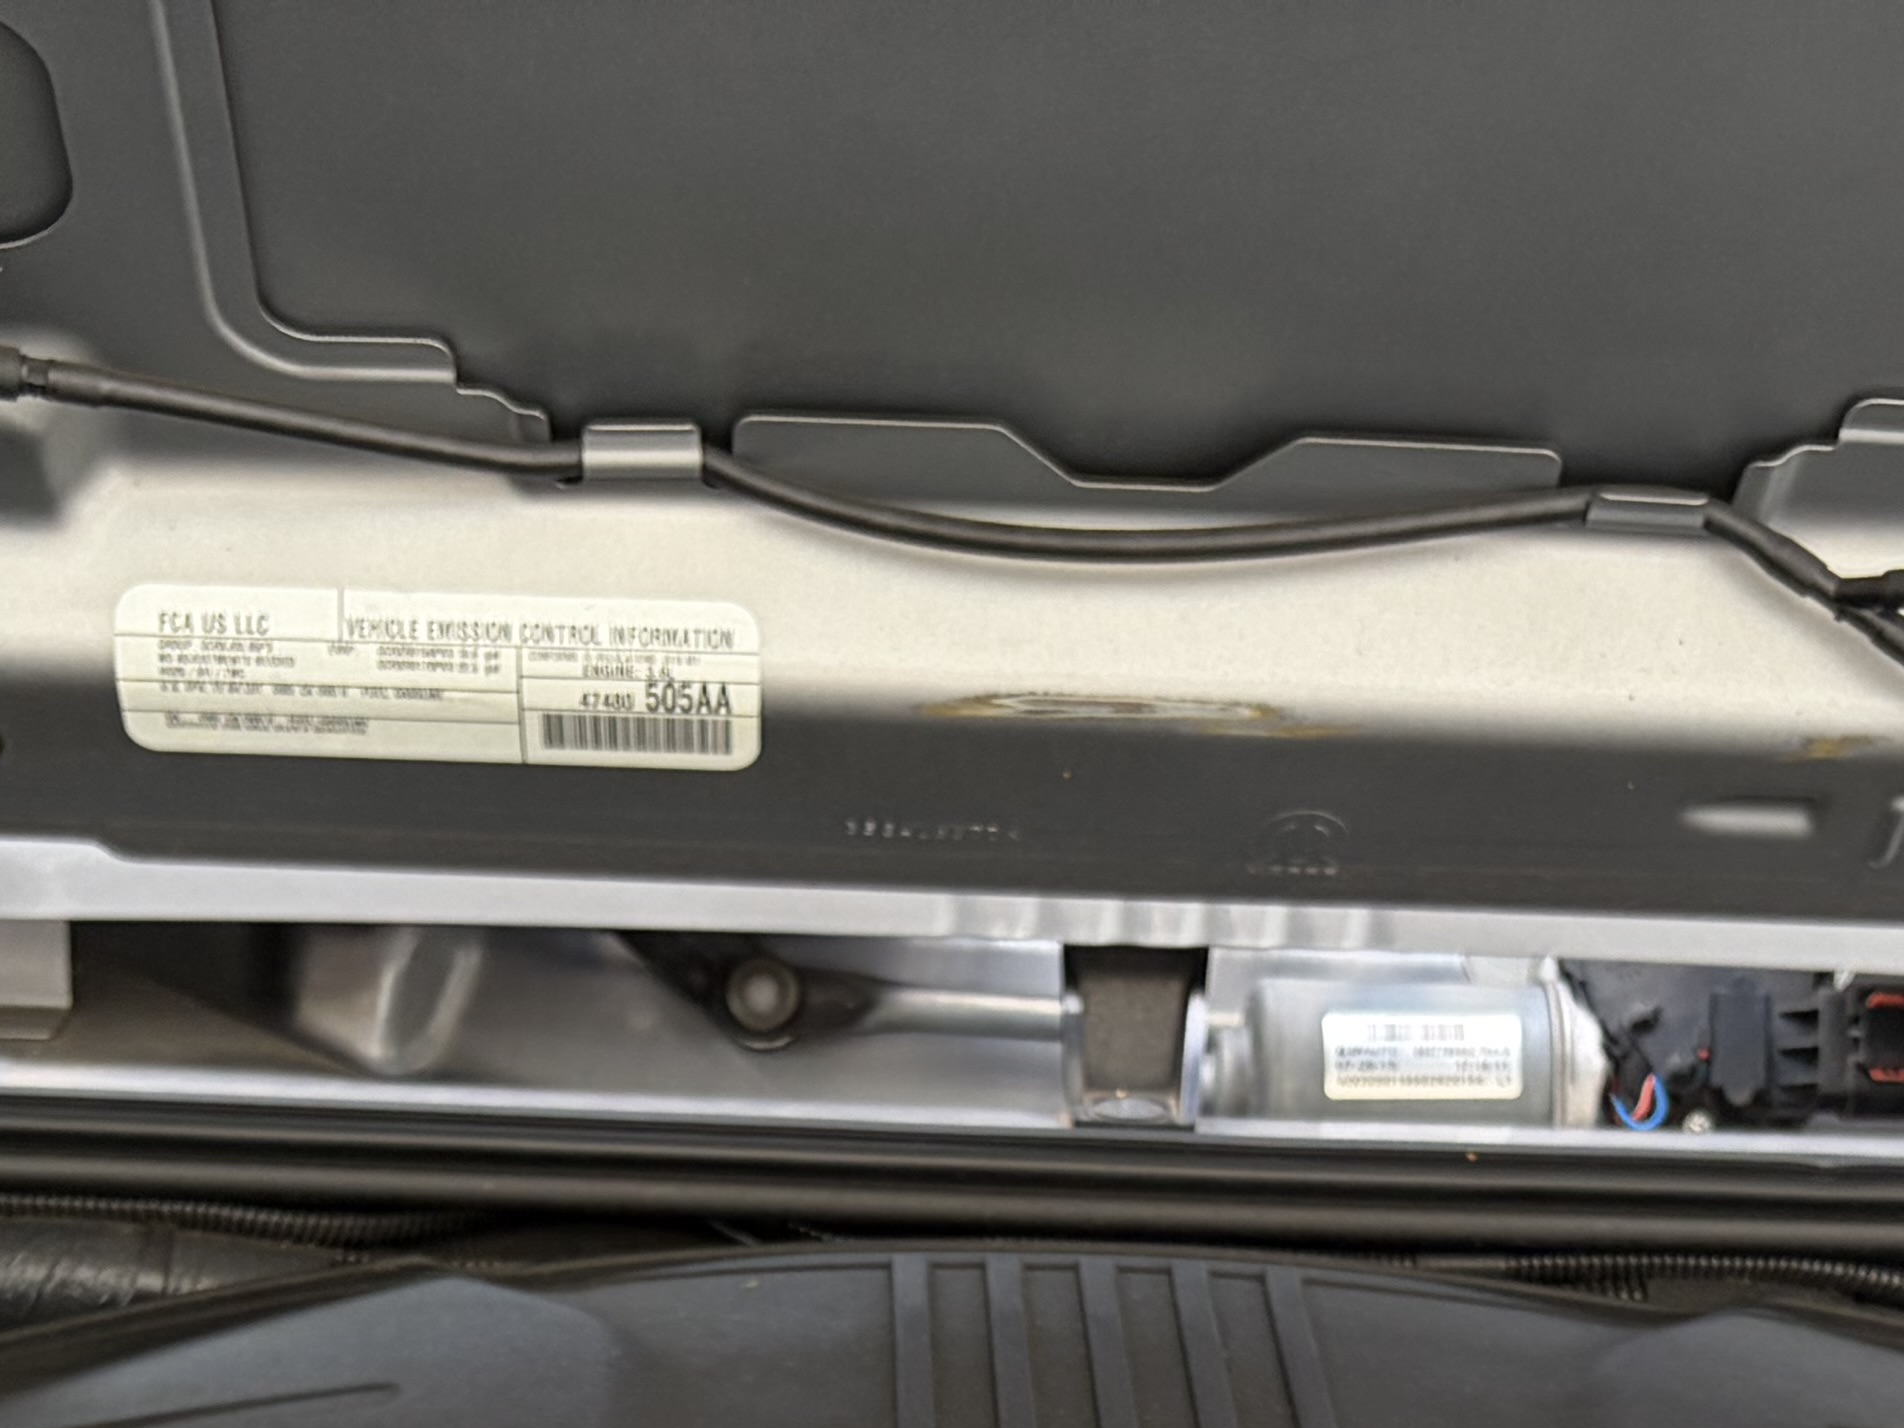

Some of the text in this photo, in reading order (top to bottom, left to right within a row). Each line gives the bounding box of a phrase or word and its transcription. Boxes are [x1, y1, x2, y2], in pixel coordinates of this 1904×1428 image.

[159, 612, 270, 636] FCA US LLC
[346, 616, 735, 649] VEHICLE EMISSION CONTROL INFORMATION
[645, 681, 733, 716] 505AA
